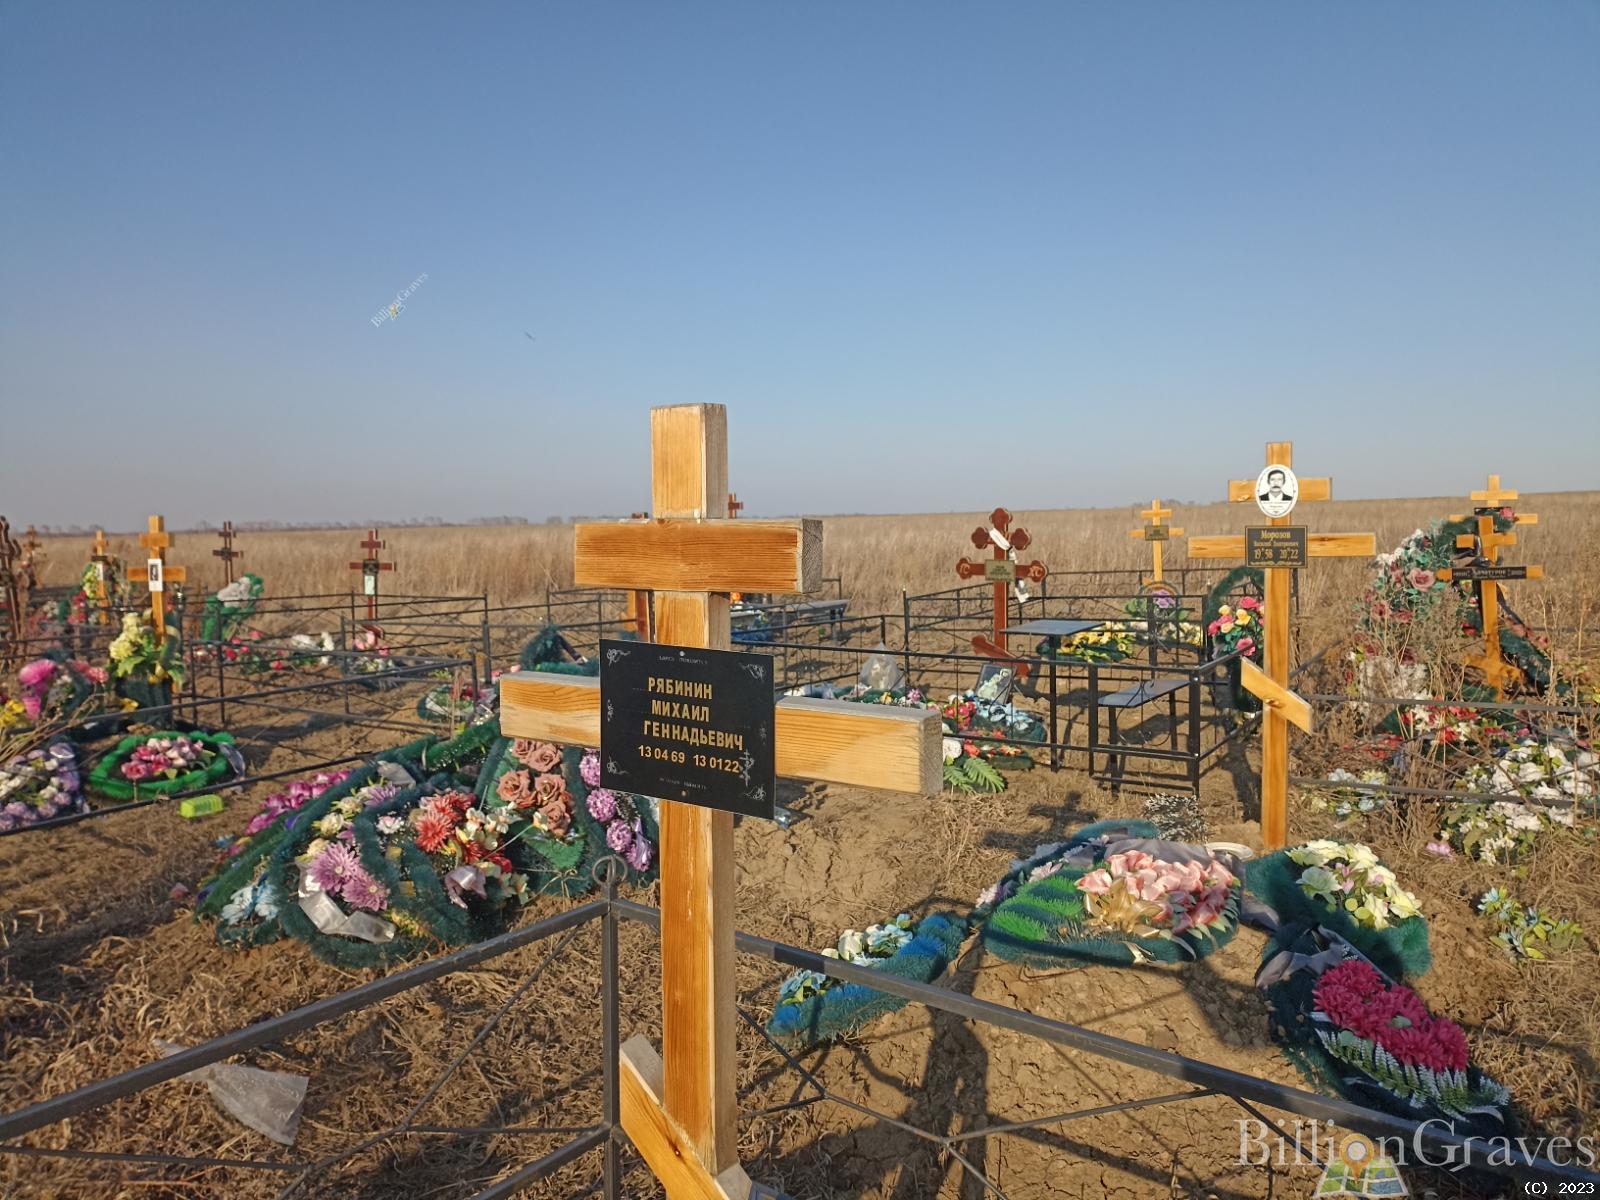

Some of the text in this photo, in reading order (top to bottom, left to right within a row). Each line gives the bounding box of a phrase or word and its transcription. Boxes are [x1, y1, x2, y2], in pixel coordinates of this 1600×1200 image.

[648, 677, 712, 699] РЯБИНИН
[651, 699, 710, 722] МИХАИЛ
[643, 720, 744, 751] ГЕННАДЬЕВИЧ
[638, 744, 652, 758] 13
[654, 747, 669, 761] 04
[671, 749, 686, 764] 69
[693, 754, 707, 767] 13
